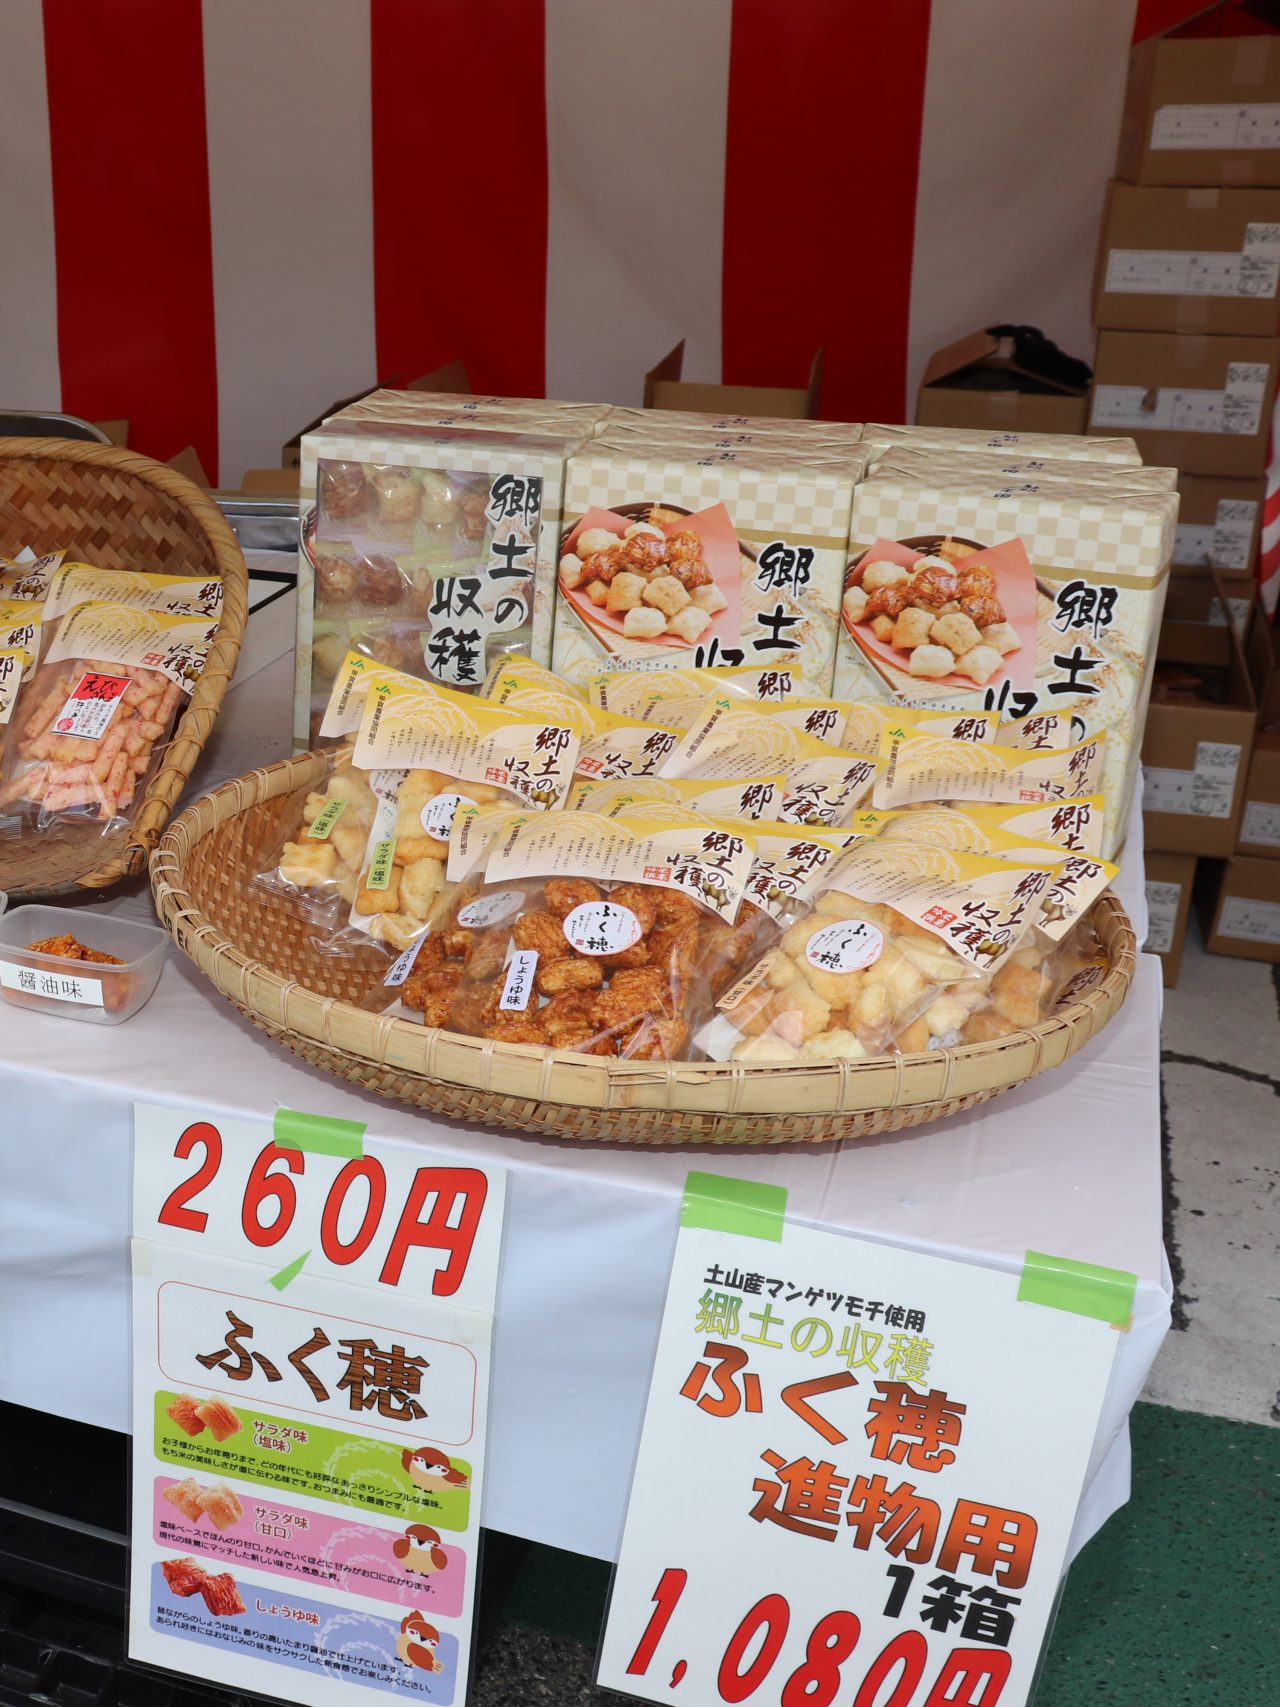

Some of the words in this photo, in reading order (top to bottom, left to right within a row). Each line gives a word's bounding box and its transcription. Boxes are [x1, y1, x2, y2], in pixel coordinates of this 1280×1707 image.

[488, 474, 540, 625] 郷土の
[428, 577, 484, 683] 収穫
[753, 543, 814, 651] 郷土
[533, 726, 573, 793] 郷土の
[667, 853, 702, 888] 収穫
[701, 831, 744, 888] 郷土の
[778, 842, 831, 895] 郷土の
[585, 905, 617, 951] ふく穂
[950, 901, 1000, 956] 収穫
[992, 872, 1051, 943] 郷土の
[506, 955, 531, 1005] しょうゆ味
[820, 924, 869, 969] ふく穂
[157, 1121, 489, 1297] 260円
[704, 1264, 927, 1334] 土山産マンゲツモチ使用
[195, 1310, 430, 1422] ふく穂
[694, 1287, 935, 1387] 郷土の収穫
[252, 1420, 309, 1443] サラダ味
[679, 1341, 967, 1473] ふく穂
[255, 1506, 310, 1529] サラダ味
[749, 1449, 1038, 1590] 進物用
[255, 1599, 320, 1626] しょうゆ味
[882, 1564, 1022, 1648] 1箱
